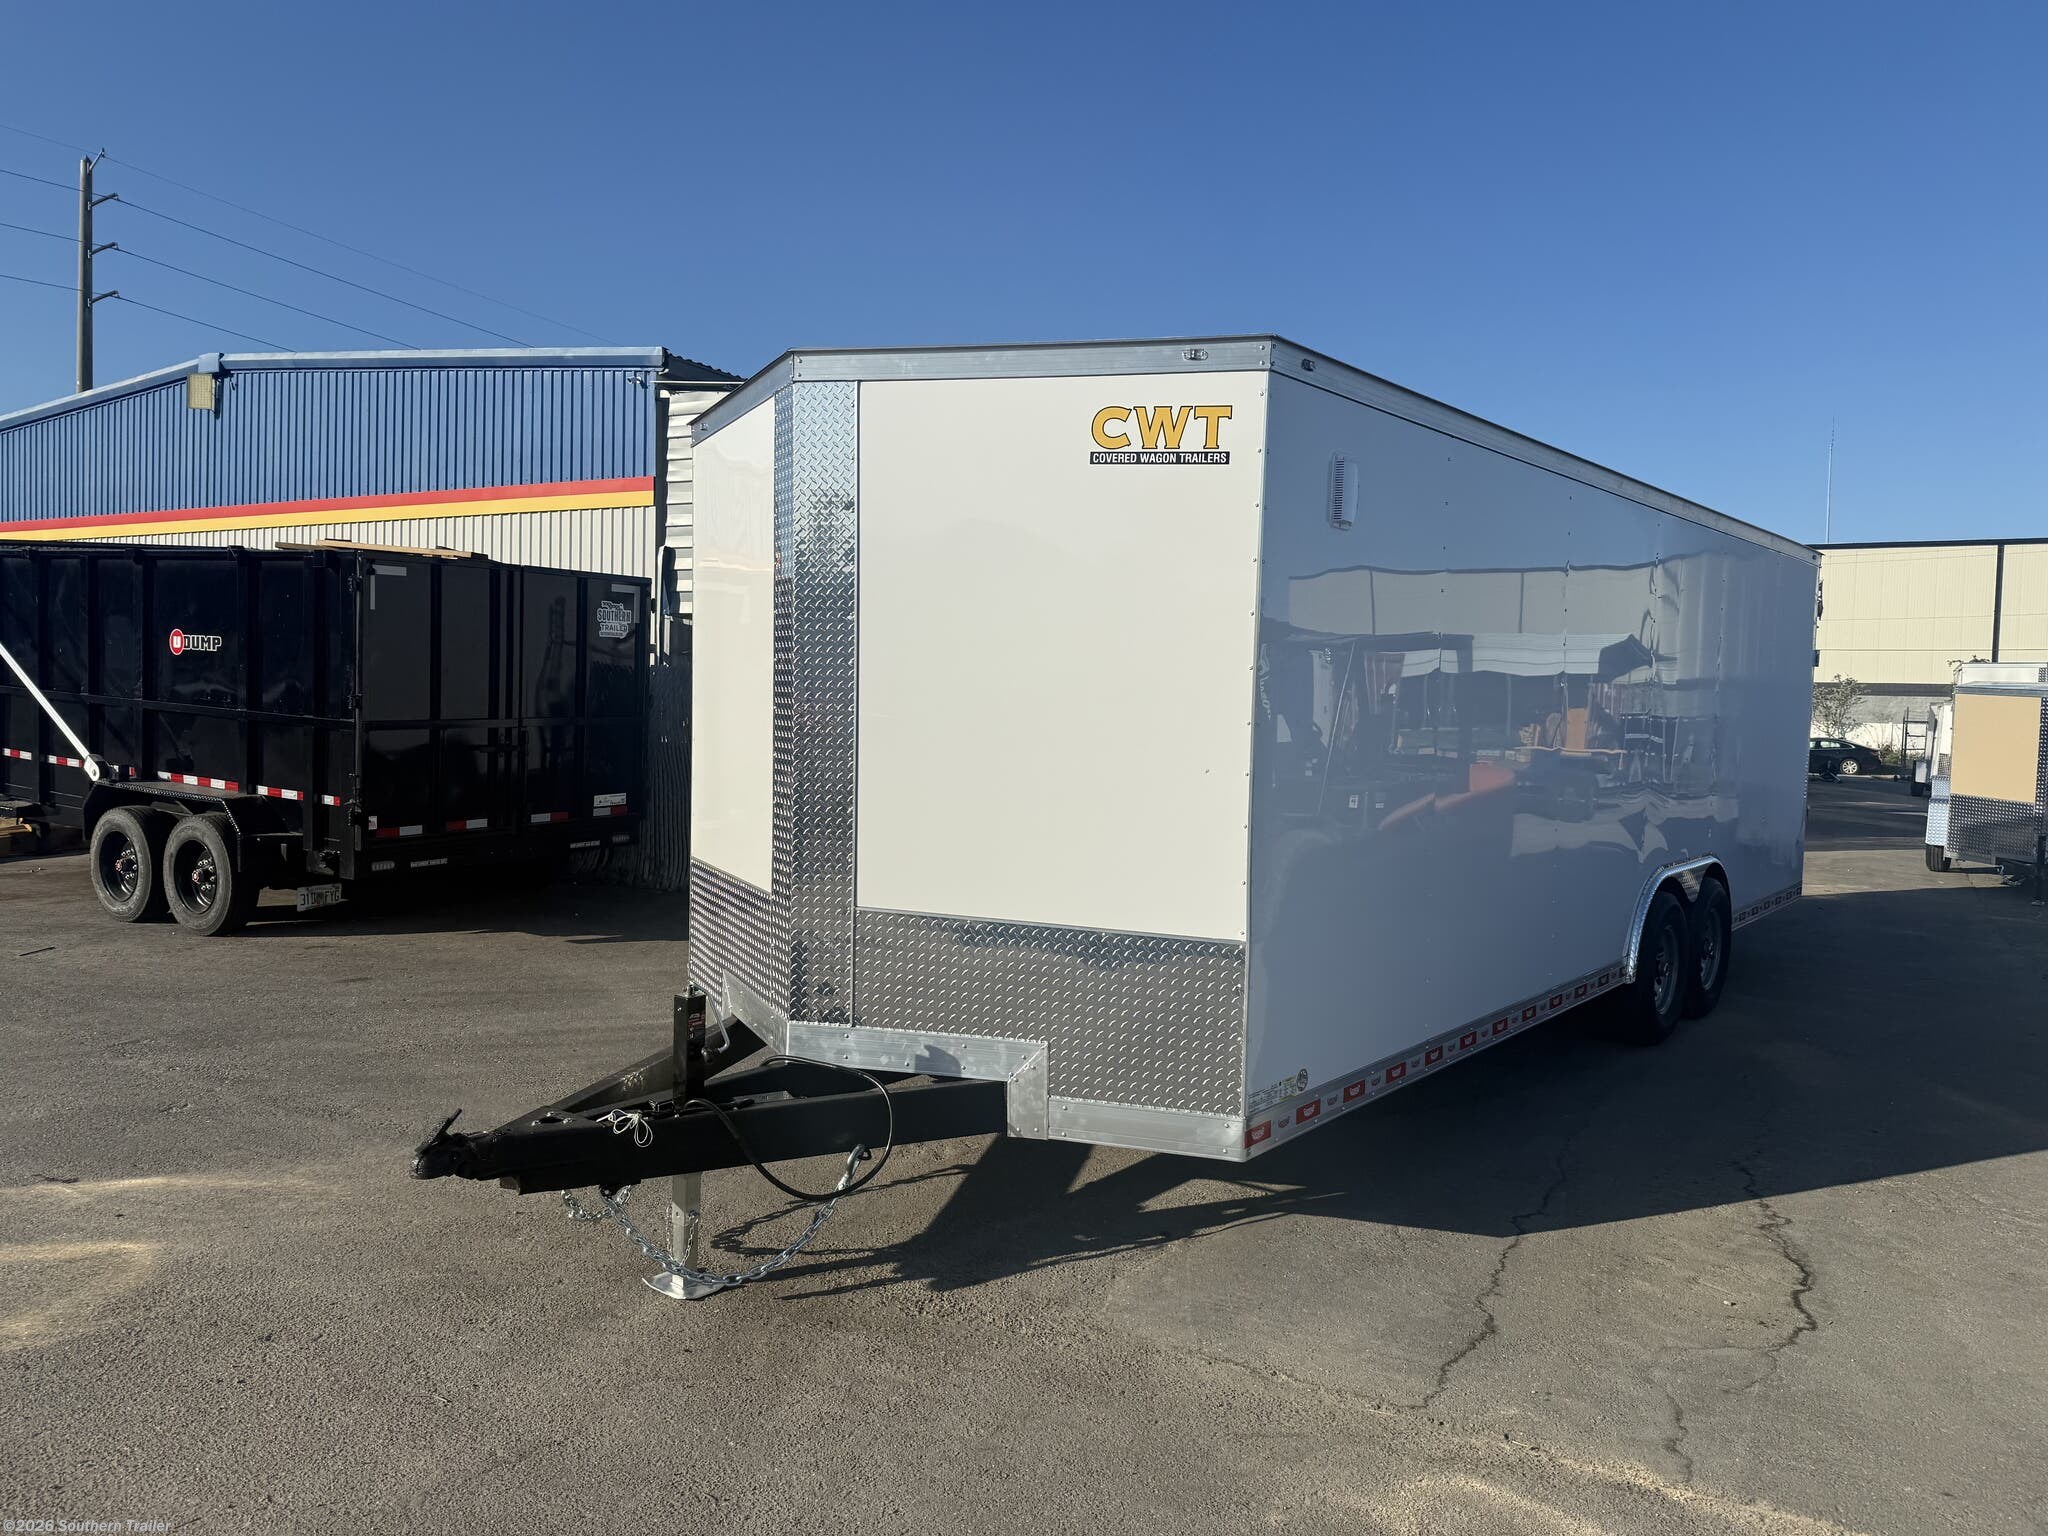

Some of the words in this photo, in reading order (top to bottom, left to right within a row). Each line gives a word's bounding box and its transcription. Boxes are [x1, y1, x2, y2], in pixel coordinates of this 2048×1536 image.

[1091, 405, 1232, 449] CWT
[1092, 453, 1137, 464] COVERED
[1140, 453, 1176, 464] WAGON
[1180, 452, 1227, 464] TRAILERS
[597, 608, 631, 623] SOUTHERN
[600, 623, 628, 633] TRAILER
